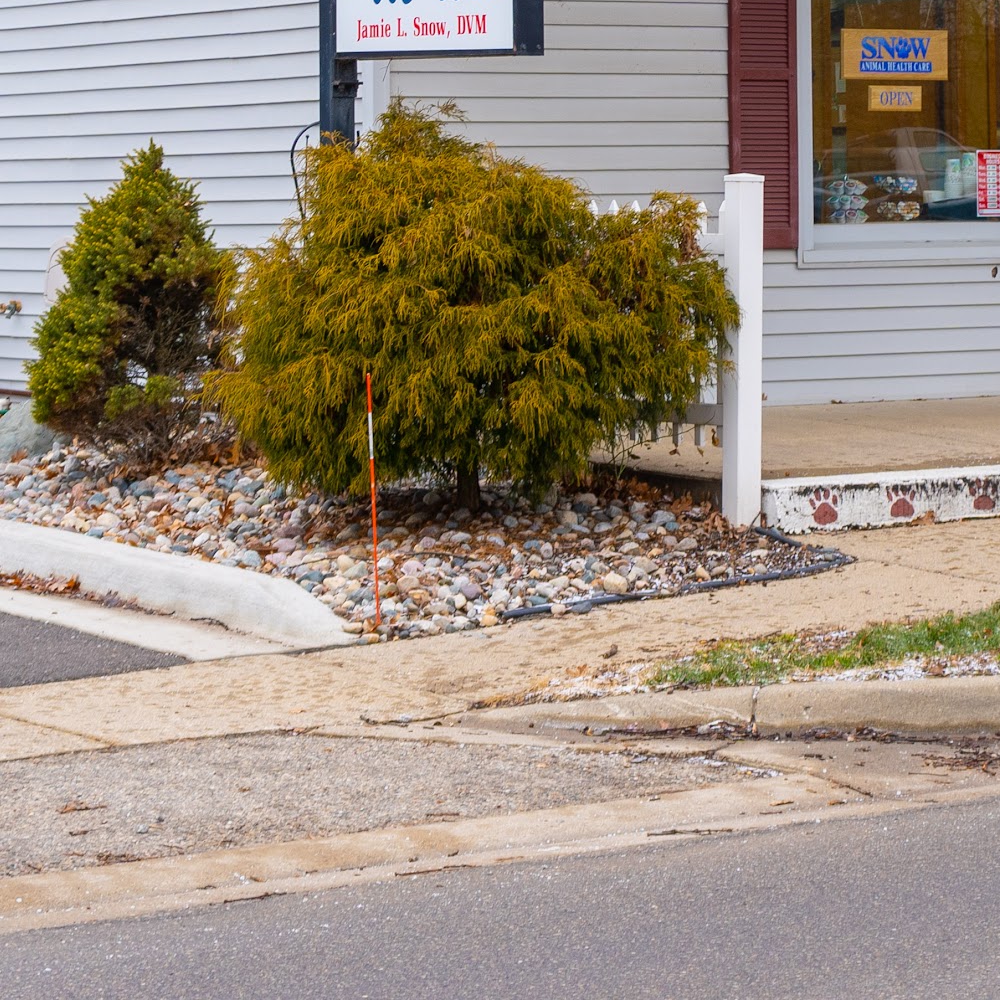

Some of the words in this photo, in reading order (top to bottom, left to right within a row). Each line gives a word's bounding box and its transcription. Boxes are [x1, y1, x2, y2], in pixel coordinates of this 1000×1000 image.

[357, 18, 391, 42] Jamie
[397, 18, 408, 37] L.
[413, 16, 451, 39] Snow,
[457, 14, 487, 35] DVM
[861, 61, 887, 71] ANIMAL
[887, 61, 913, 71] HEALTH
[913, 62, 931, 72] CARE
[880, 90, 913, 106] OPEN
